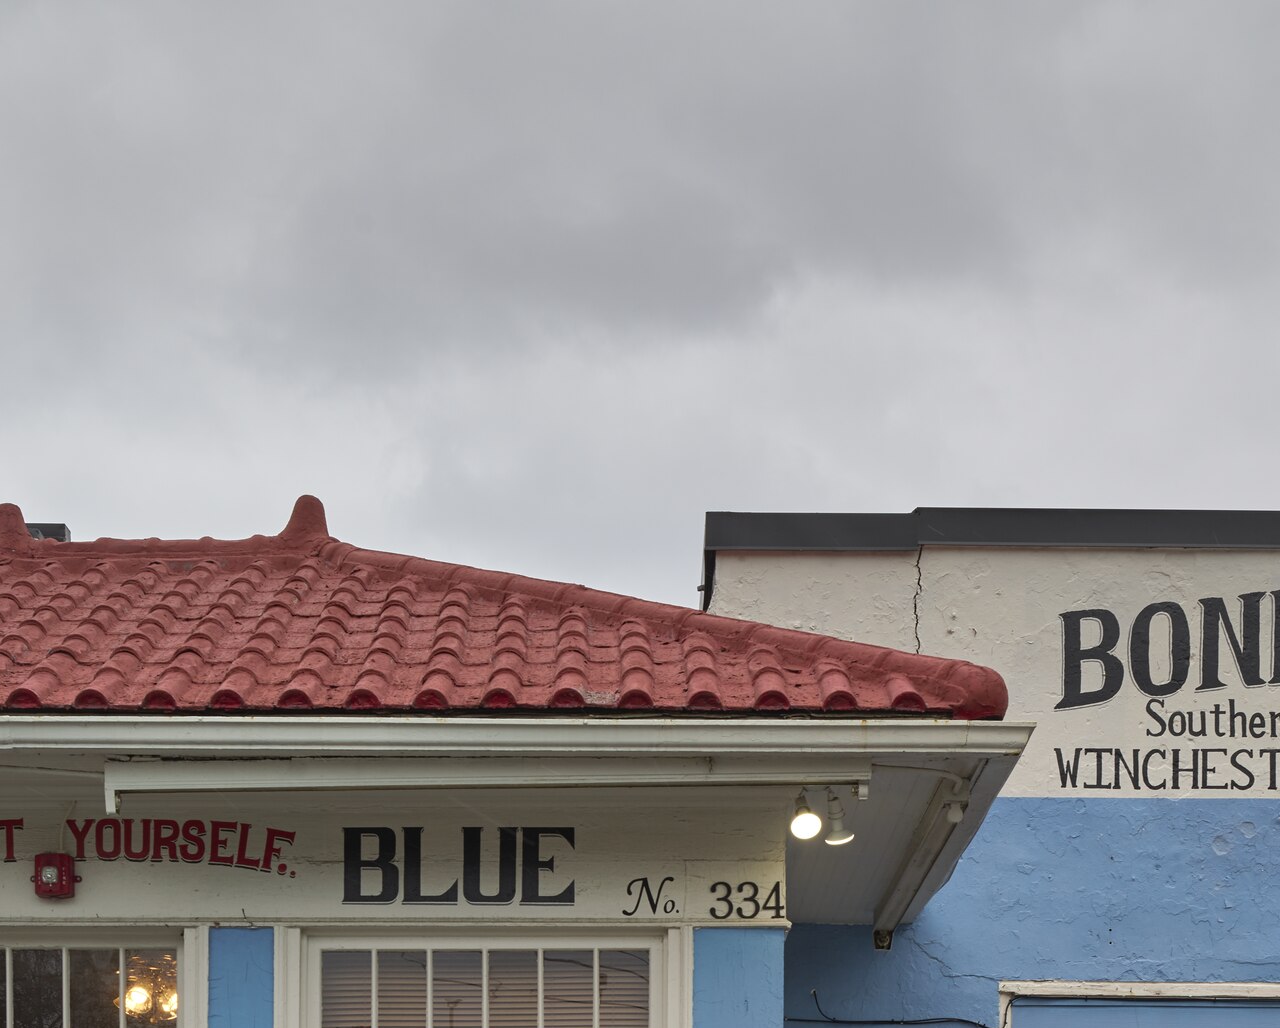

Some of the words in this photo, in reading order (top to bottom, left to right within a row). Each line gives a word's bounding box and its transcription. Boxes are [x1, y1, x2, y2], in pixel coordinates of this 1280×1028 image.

[341, 825, 576, 907] BLUE
[621, 875, 681, 918] No.
[708, 880, 786, 921] 334
